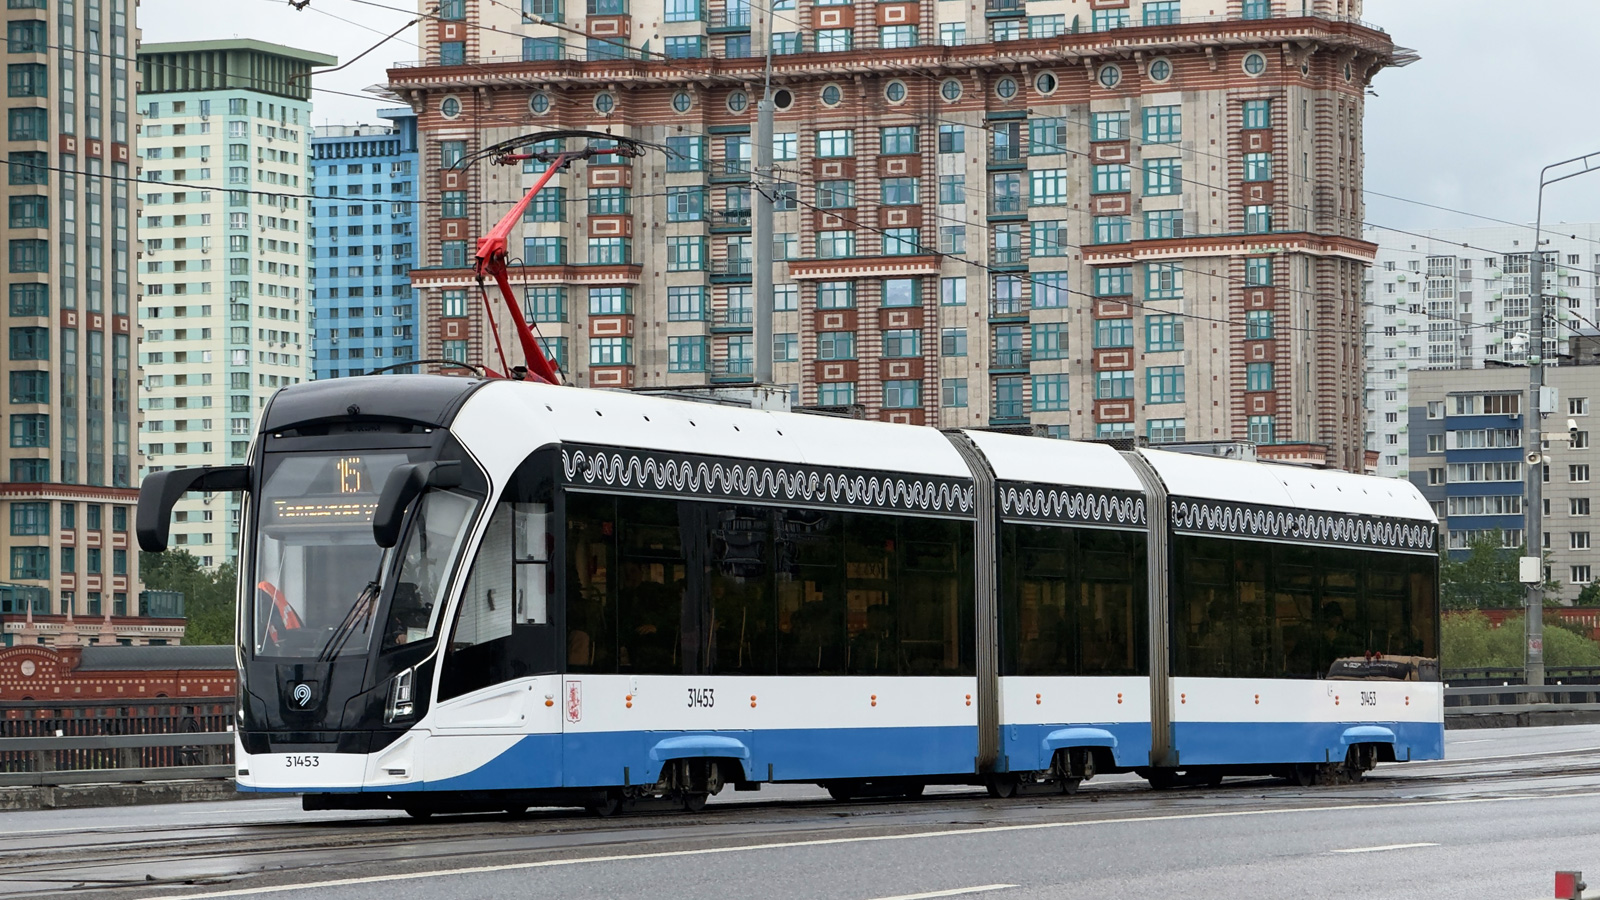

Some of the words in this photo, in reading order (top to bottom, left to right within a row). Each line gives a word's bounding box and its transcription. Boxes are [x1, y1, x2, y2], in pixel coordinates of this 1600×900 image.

[337, 457, 360, 493] 15
[687, 688, 715, 708] 31453
[1360, 691, 1377, 706] 31453
[285, 755, 320, 768] 31453
